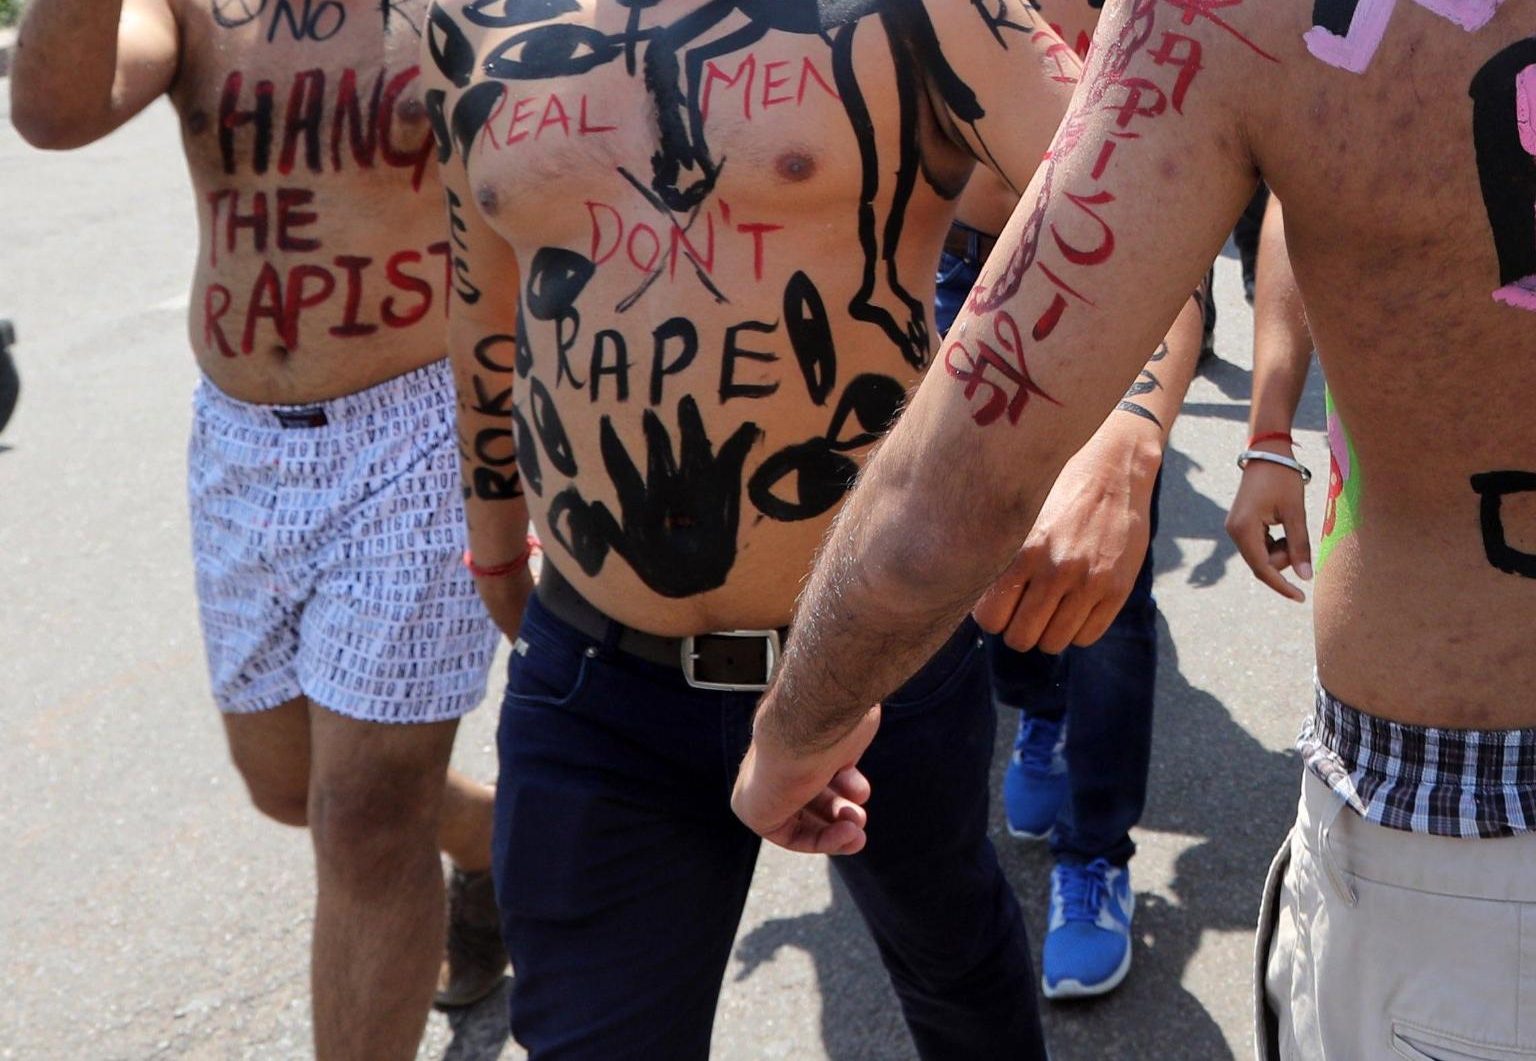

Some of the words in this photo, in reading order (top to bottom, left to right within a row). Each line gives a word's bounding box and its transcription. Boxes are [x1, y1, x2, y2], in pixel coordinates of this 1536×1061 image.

[217, 63, 434, 194] HANG
[479, 85, 618, 151] REAL
[700, 52, 843, 122] MEN
[206, 187, 323, 270] THE
[584, 197, 785, 282] DON'T
[555, 304, 781, 407] RAPE
